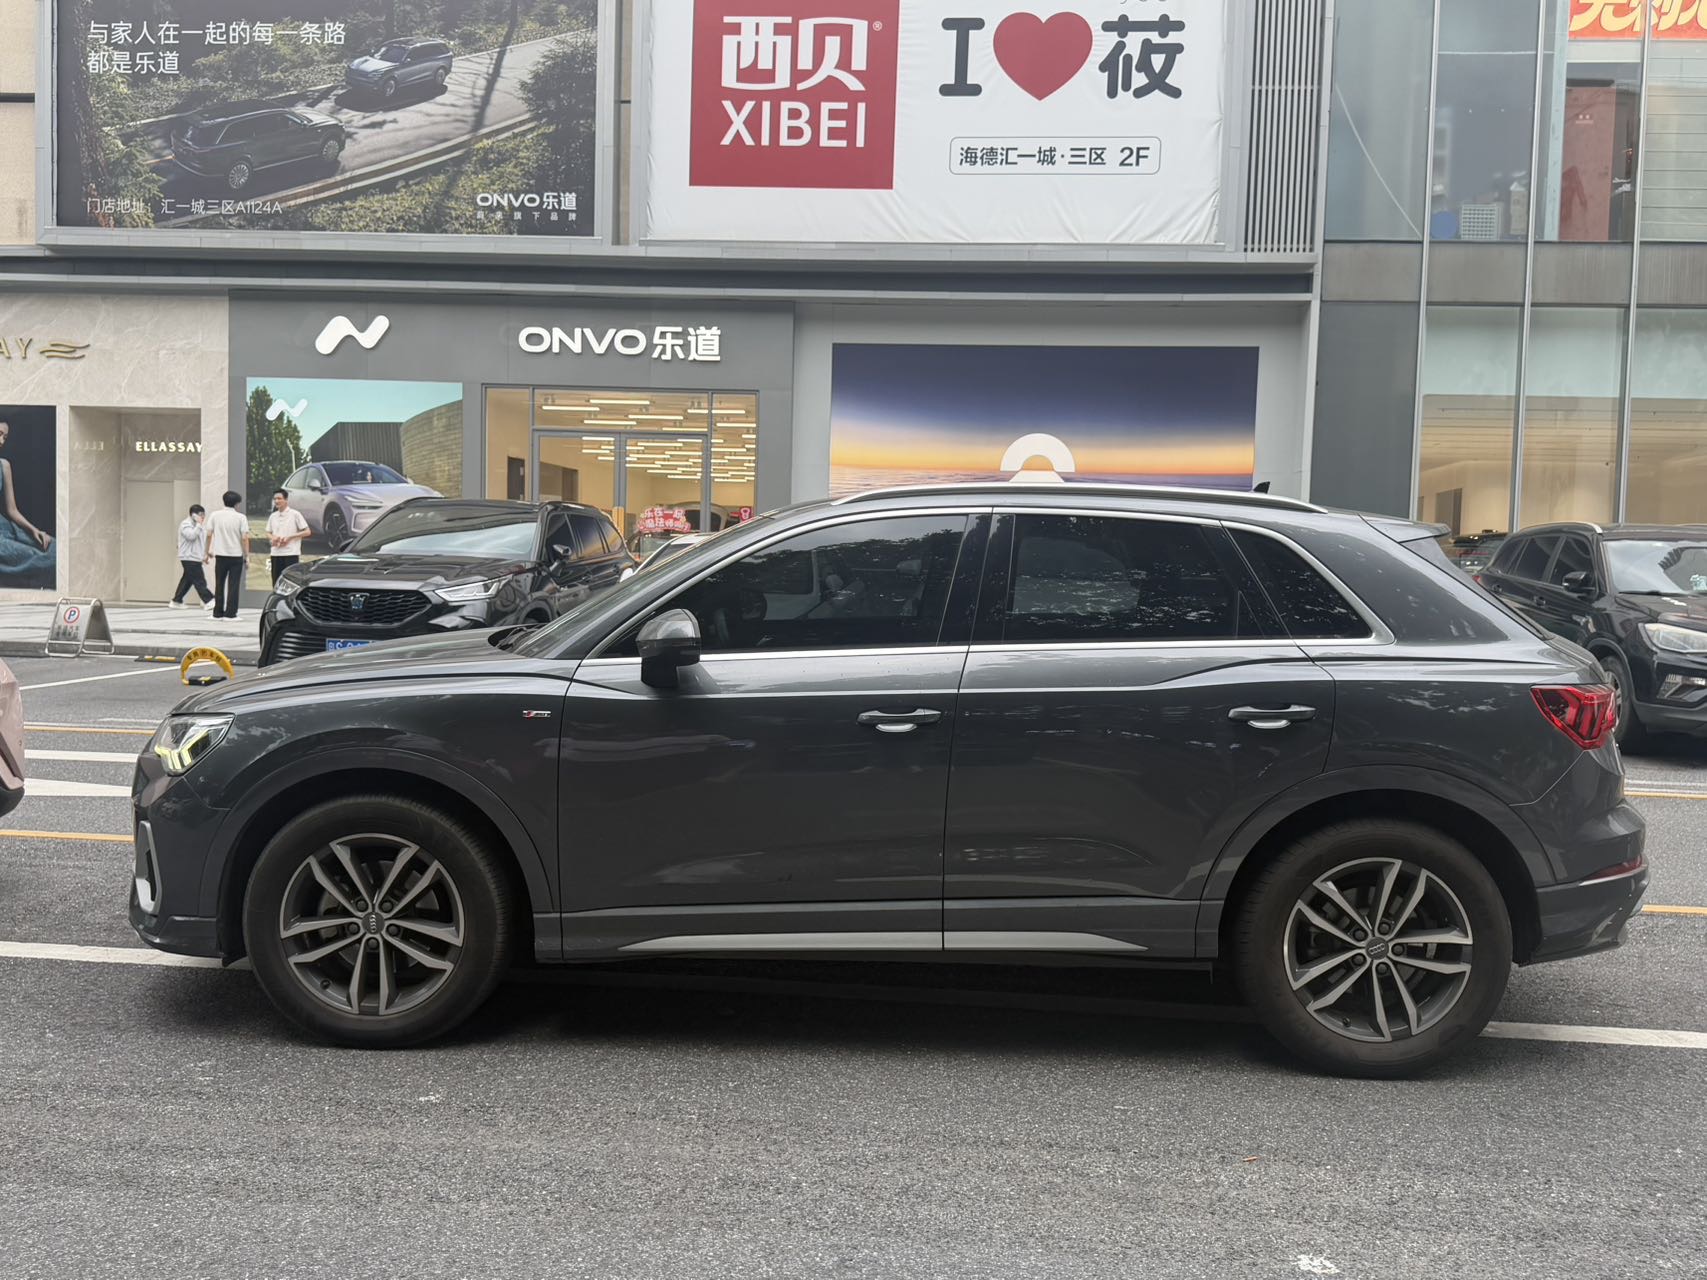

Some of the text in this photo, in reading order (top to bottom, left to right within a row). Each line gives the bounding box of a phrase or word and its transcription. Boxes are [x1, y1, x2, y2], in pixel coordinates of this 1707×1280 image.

[87, 20, 346, 46] 与家人在一起的每一条路
[87, 50, 180, 75] 都是乐道
[938, 13, 1187, 100] I 莜
[719, 99, 867, 149] XIBEI
[1119, 146, 1150, 168] 2F
[135, 440, 203, 453] ELLASSAY
